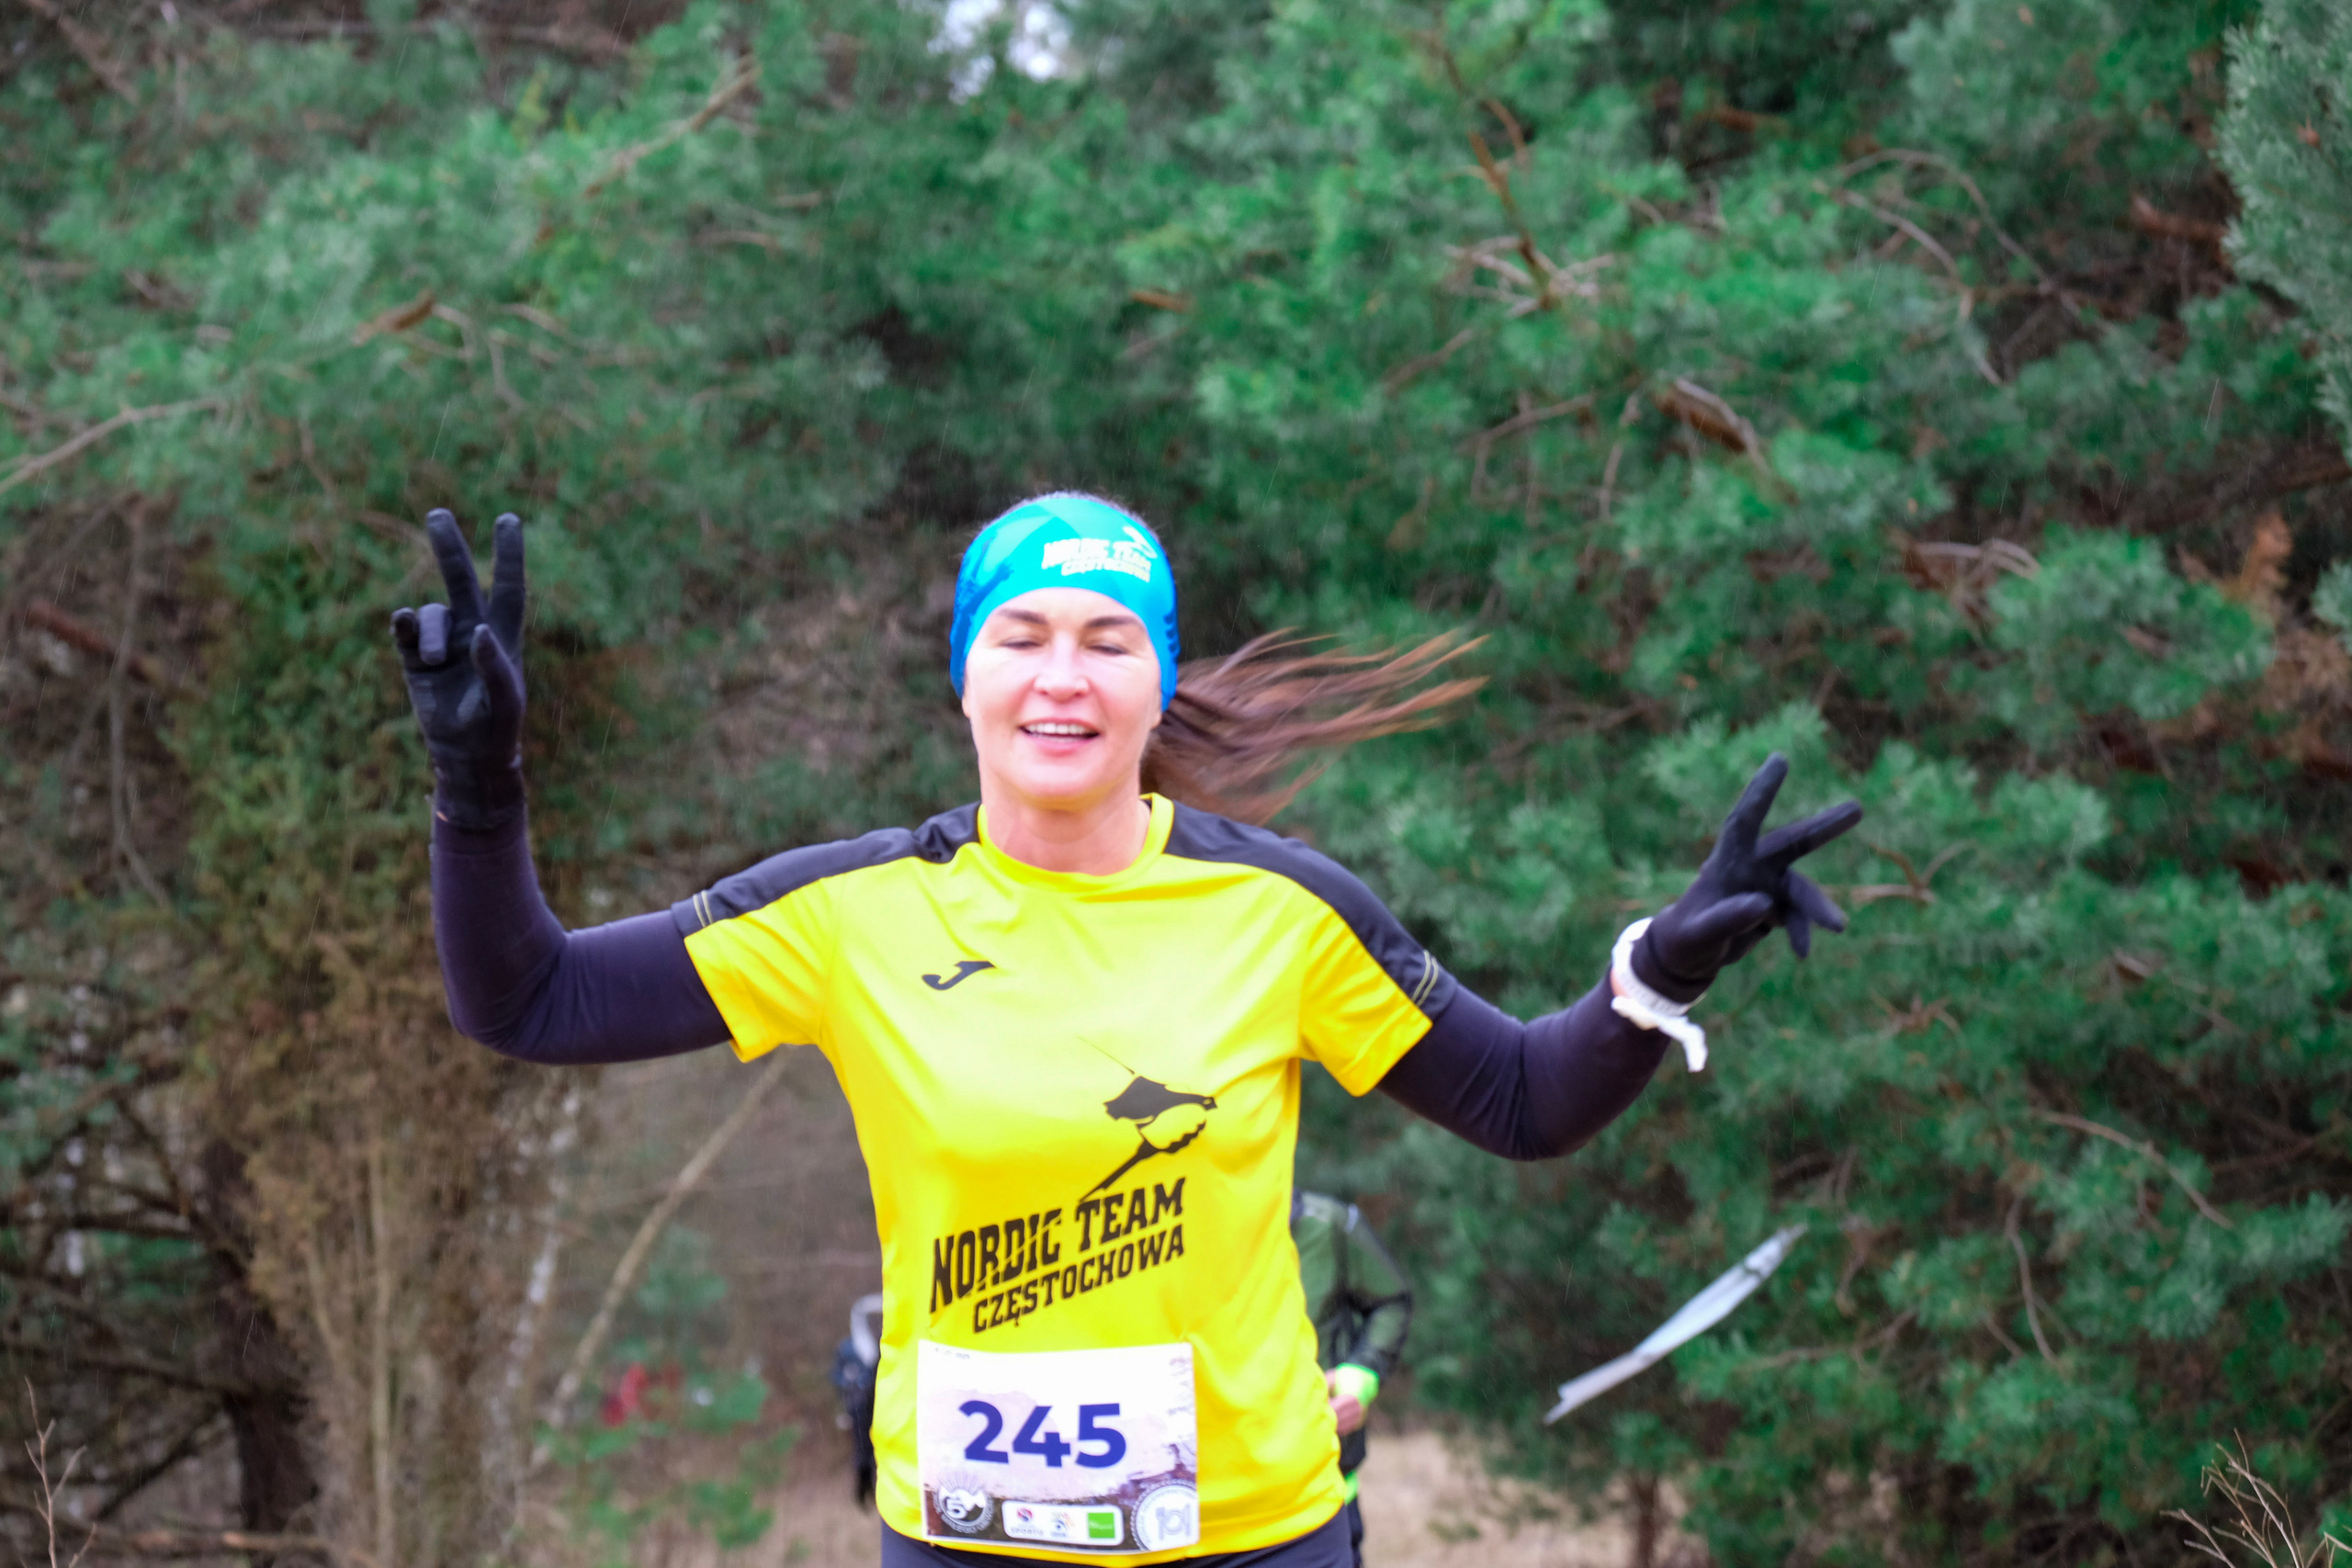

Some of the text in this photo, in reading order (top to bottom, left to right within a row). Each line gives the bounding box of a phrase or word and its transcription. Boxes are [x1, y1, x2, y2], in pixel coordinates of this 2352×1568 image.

[929, 1177, 1186, 1314] NORDIC TEAM
[972, 1224, 1185, 1335] CZĘSTOCHOWA
[958, 1400, 1126, 1469] 245
